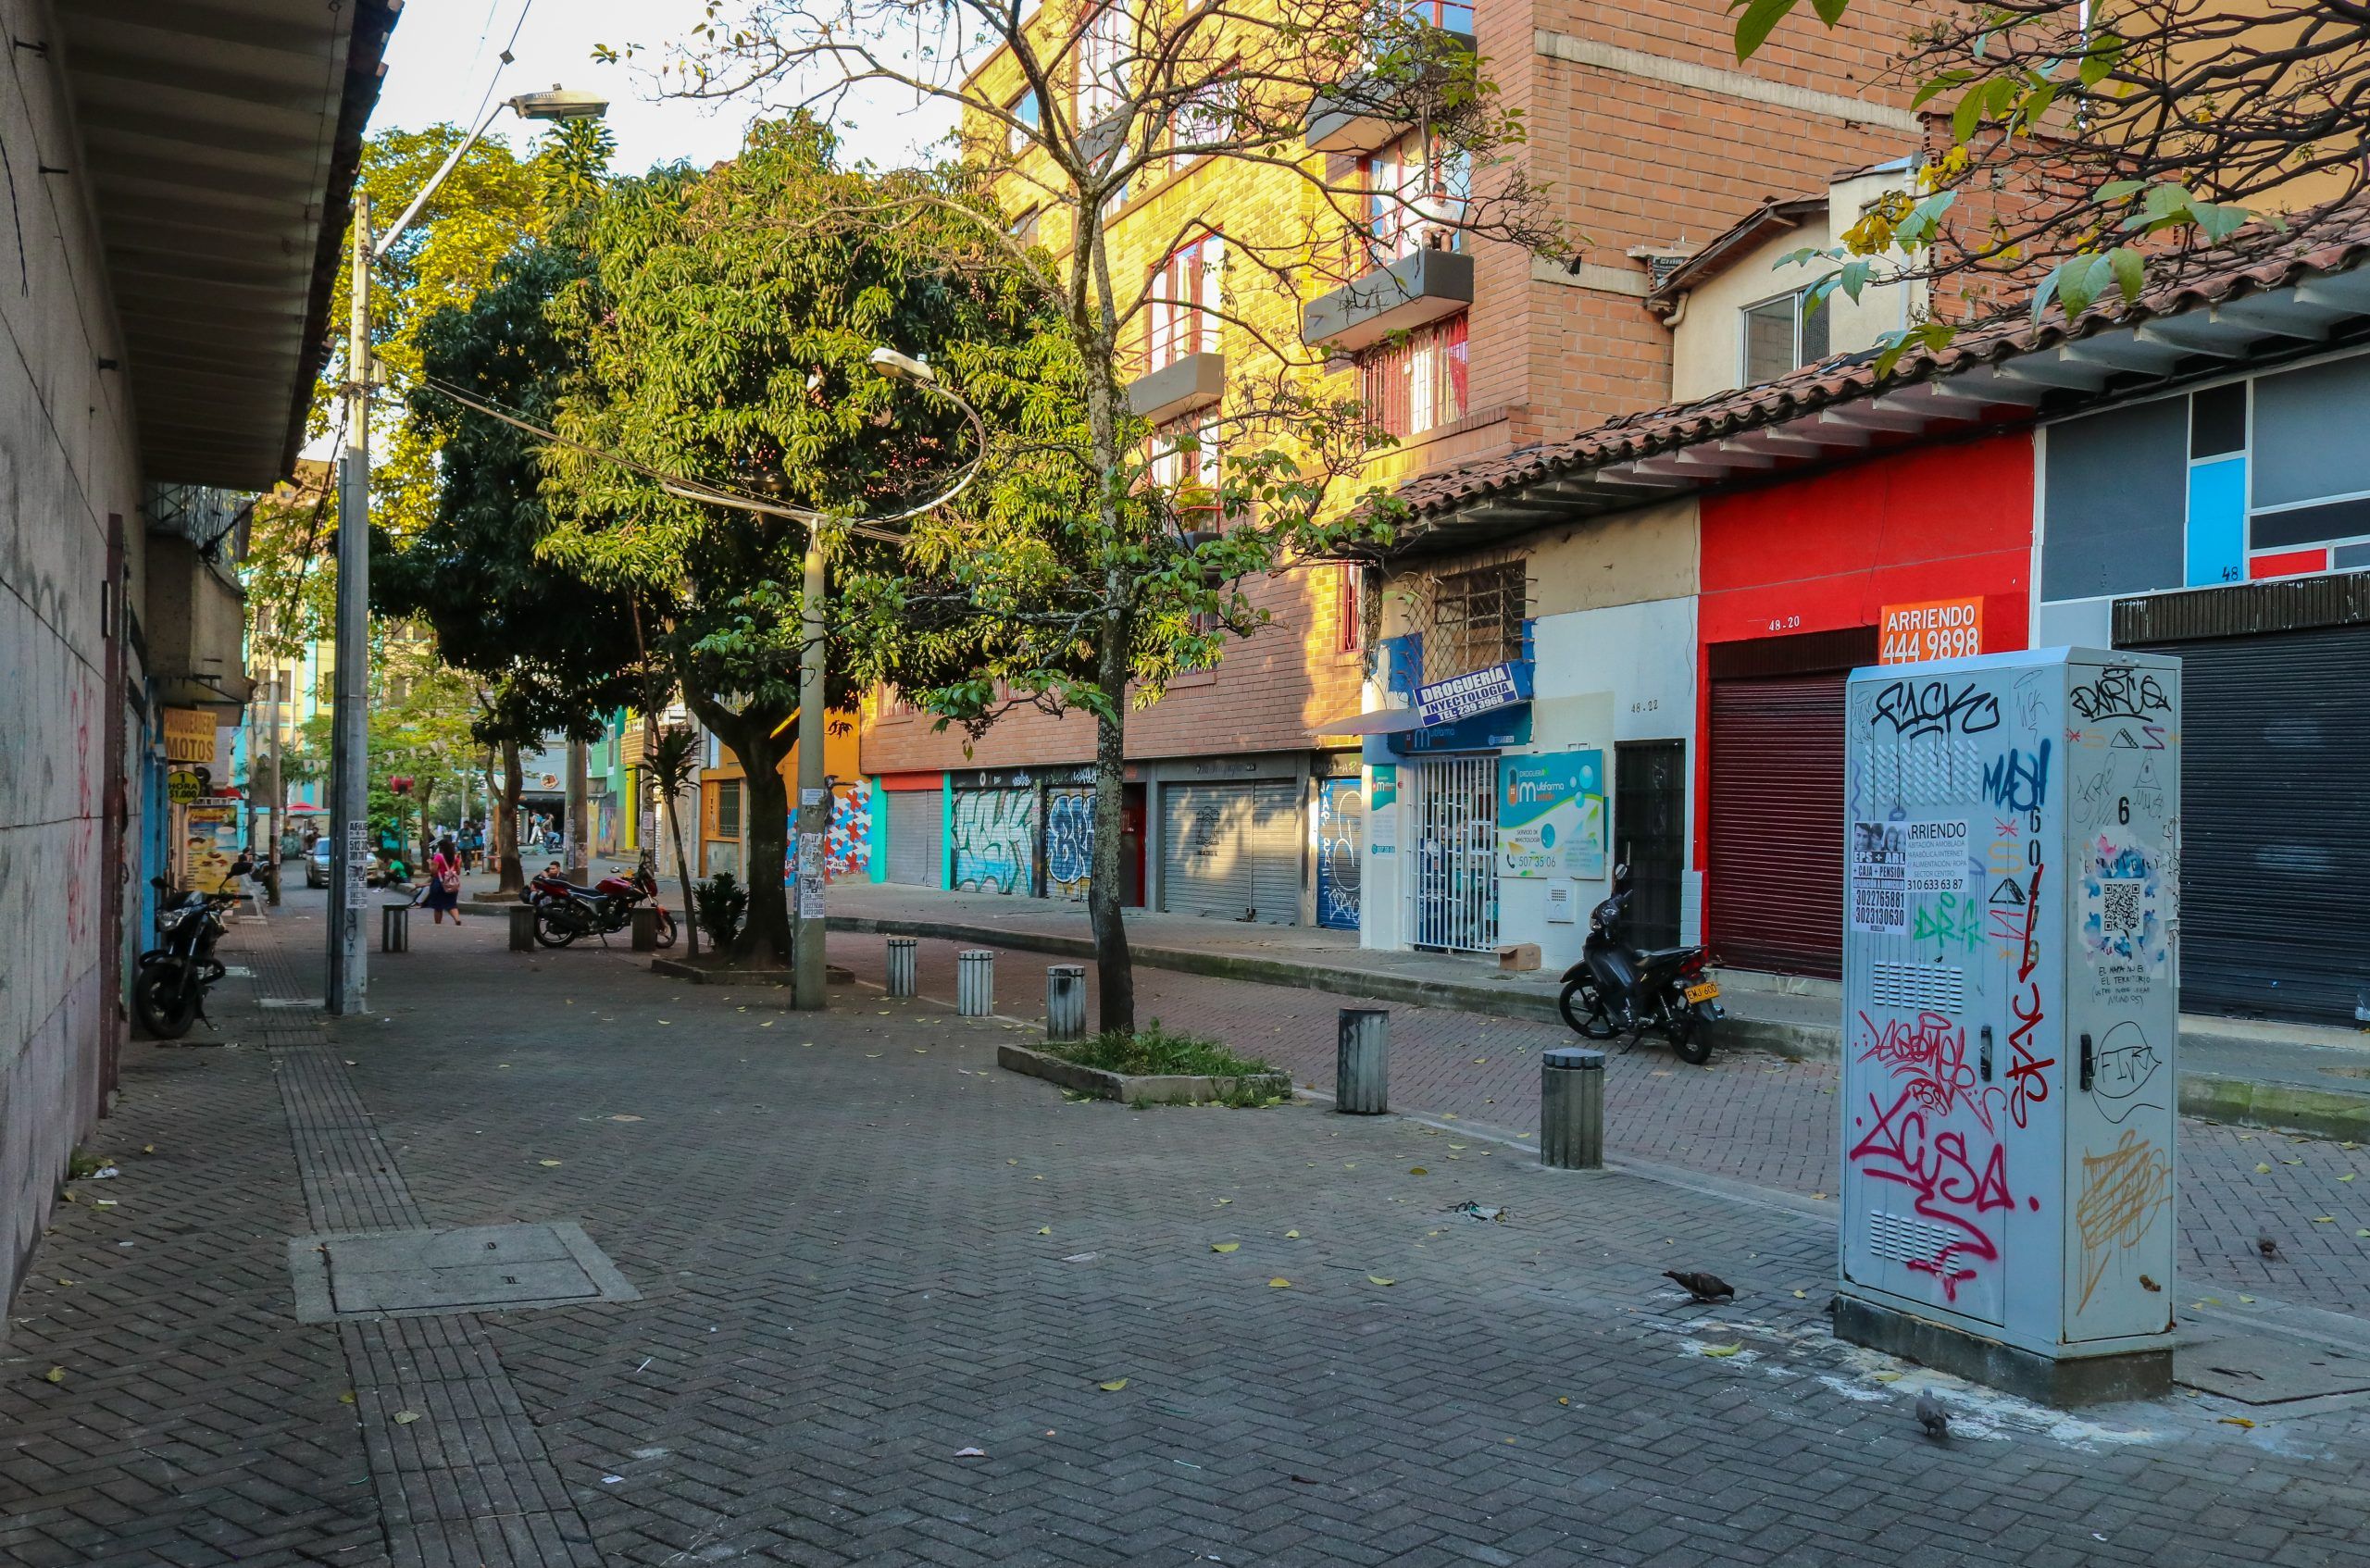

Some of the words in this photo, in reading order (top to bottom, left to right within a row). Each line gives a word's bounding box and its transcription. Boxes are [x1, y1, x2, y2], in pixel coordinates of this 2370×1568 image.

[1887, 604, 1976, 632] ARRIENDO
[1883, 632, 1920, 665] 444
[1927, 627, 1979, 661] 9898
[1421, 666, 1507, 703] DROGUERÍA
[1459, 704, 1478, 716] 239
[1479, 694, 1504, 709] 3968
[168, 737, 214, 762] MOTOS
[2118, 796, 2129, 825] 6
[1519, 856, 1532, 867] 507
[1535, 856, 1543, 867] 35
[1546, 856, 1555, 867] 06
[1853, 851, 1873, 863] EPS
[1885, 852, 1905, 865] ARL
[1858, 865, 1873, 877] CAJA
[1879, 865, 1905, 878] PENSIÓN
[1907, 879, 1922, 890] 310
[1924, 879, 1939, 890] 633
[1940, 879, 1951, 889] 63
[1952, 878, 1964, 890] 87
[1856, 890, 1904, 908] 3022765881
[1855, 906, 1904, 927] 3023130630
